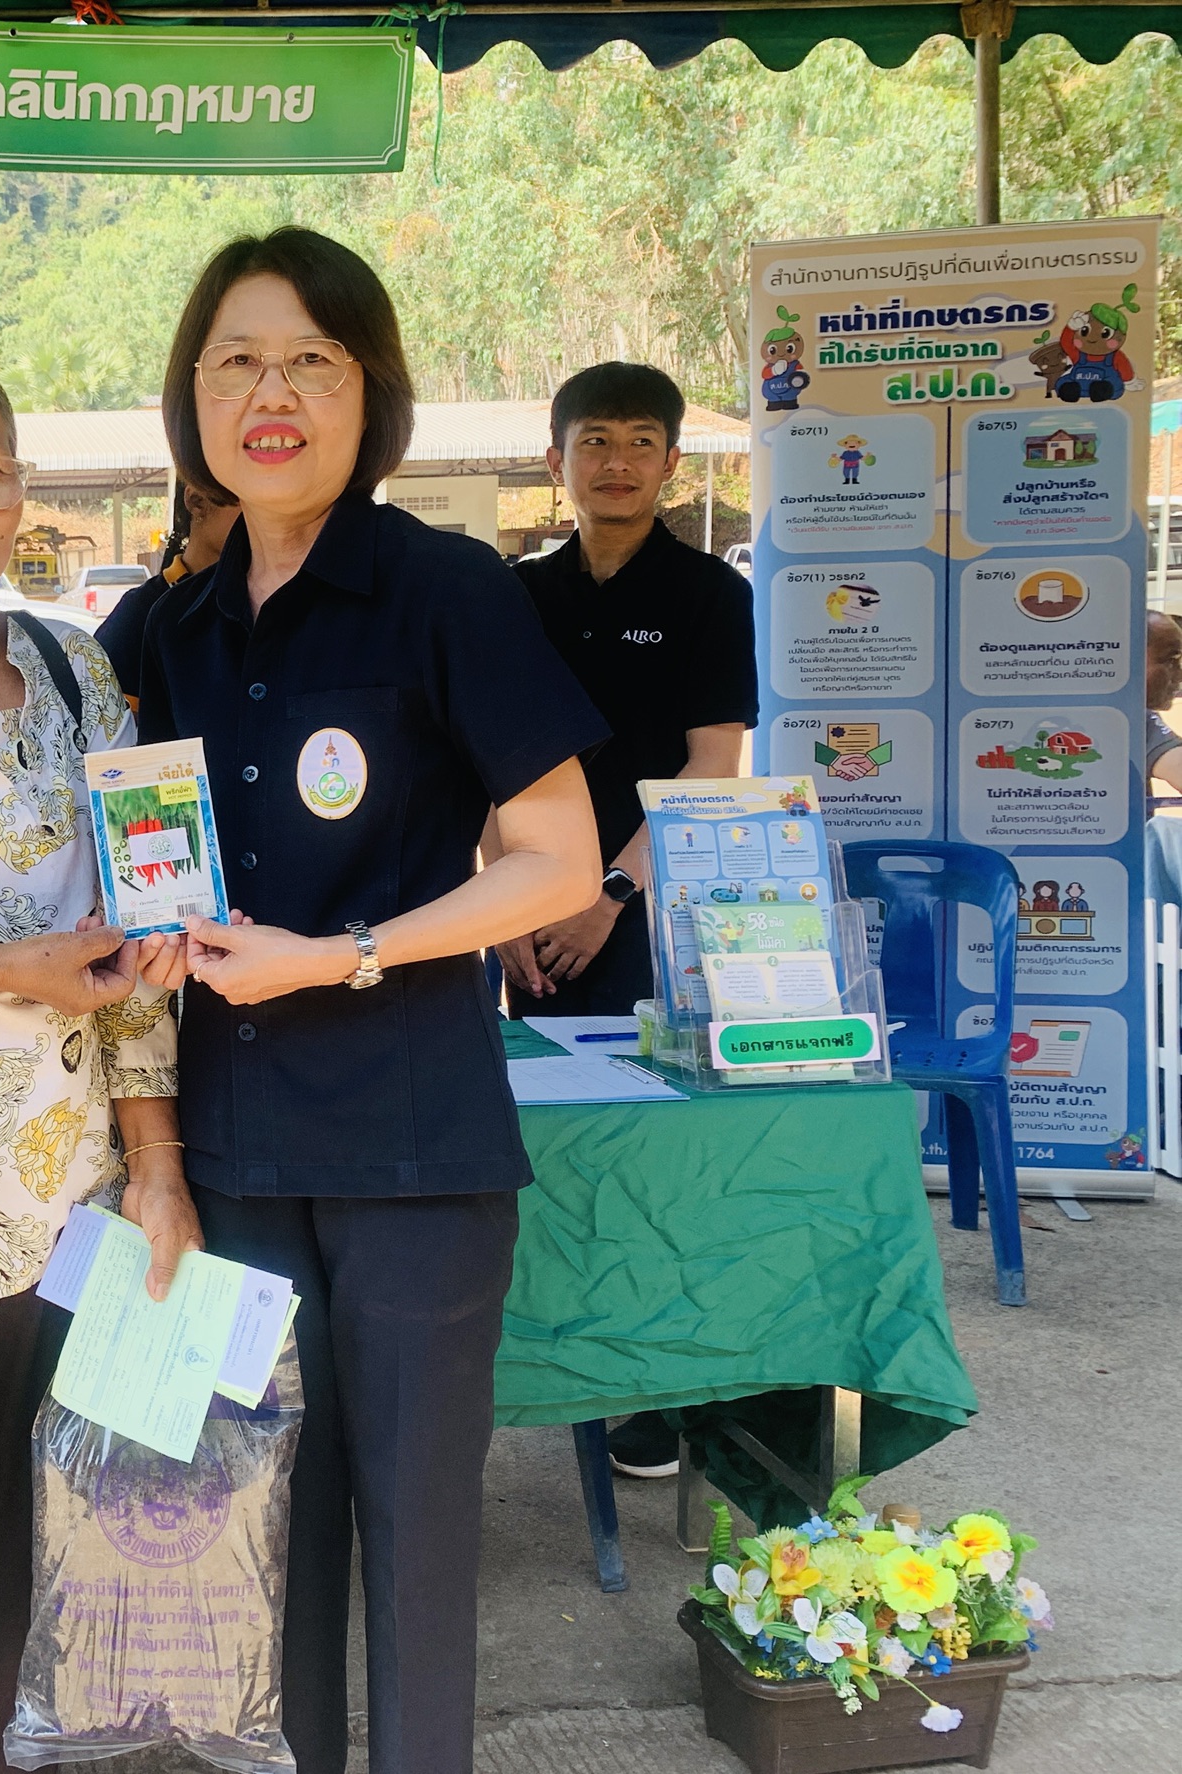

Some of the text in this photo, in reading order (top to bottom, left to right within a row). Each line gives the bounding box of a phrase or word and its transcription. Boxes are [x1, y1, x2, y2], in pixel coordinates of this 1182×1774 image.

[769, 248, 1139, 289] สำนักงานการปฏิรูปที่ดินเพื่อเกษตรกรรม
[818, 299, 1050, 333] หน้าที่เกษตรกร
[819, 337, 999, 365] ที่ได้รับที่ดินจาก
[886, 368, 1012, 402] ส.ป.ก.
[790, 426, 828, 436] ข้อ7(1)
[977, 420, 1017, 431] ข้อ7(5)
[1015, 478, 1096, 493] ปลูกบ้านหรือ
[780, 490, 926, 505] ต้องทำประโยชน์ด้วยตนเอง
[1002, 491, 1109, 505] สิ่งปลูกสร้างใดๆ
[1019, 506, 1086, 515] ได้ตามสมควร
[787, 571, 866, 583] ข้อ7(1) วรรค2
[976, 570, 1016, 581] ข้อ7(6)
[828, 627, 858, 635] ภายใน
[871, 625, 879, 634] ปี
[979, 640, 1120, 654] ต้องดูแลหมุดหลักฐาน
[985, 656, 1070, 668] และหลักเขตที่ดิน
[783, 718, 821, 729] ข้อ7(2)
[974, 718, 1014, 730] ข้อ7(7)
[158, 762, 195, 781] เจียไต๋
[660, 792, 735, 805] หน้าที่เกษตรกร
[987, 785, 1108, 799] ไม่ทำให้สิ่งก่อสร้าง
[997, 802, 1090, 811] และสภาพแวดล้อม
[747, 911, 768, 931] 58
[730, 1032, 854, 1053] เอกสารแจกฟรี
[1017, 1146, 1055, 1160] 1764
[202, 1577, 255, 1602] จันทบุรี
